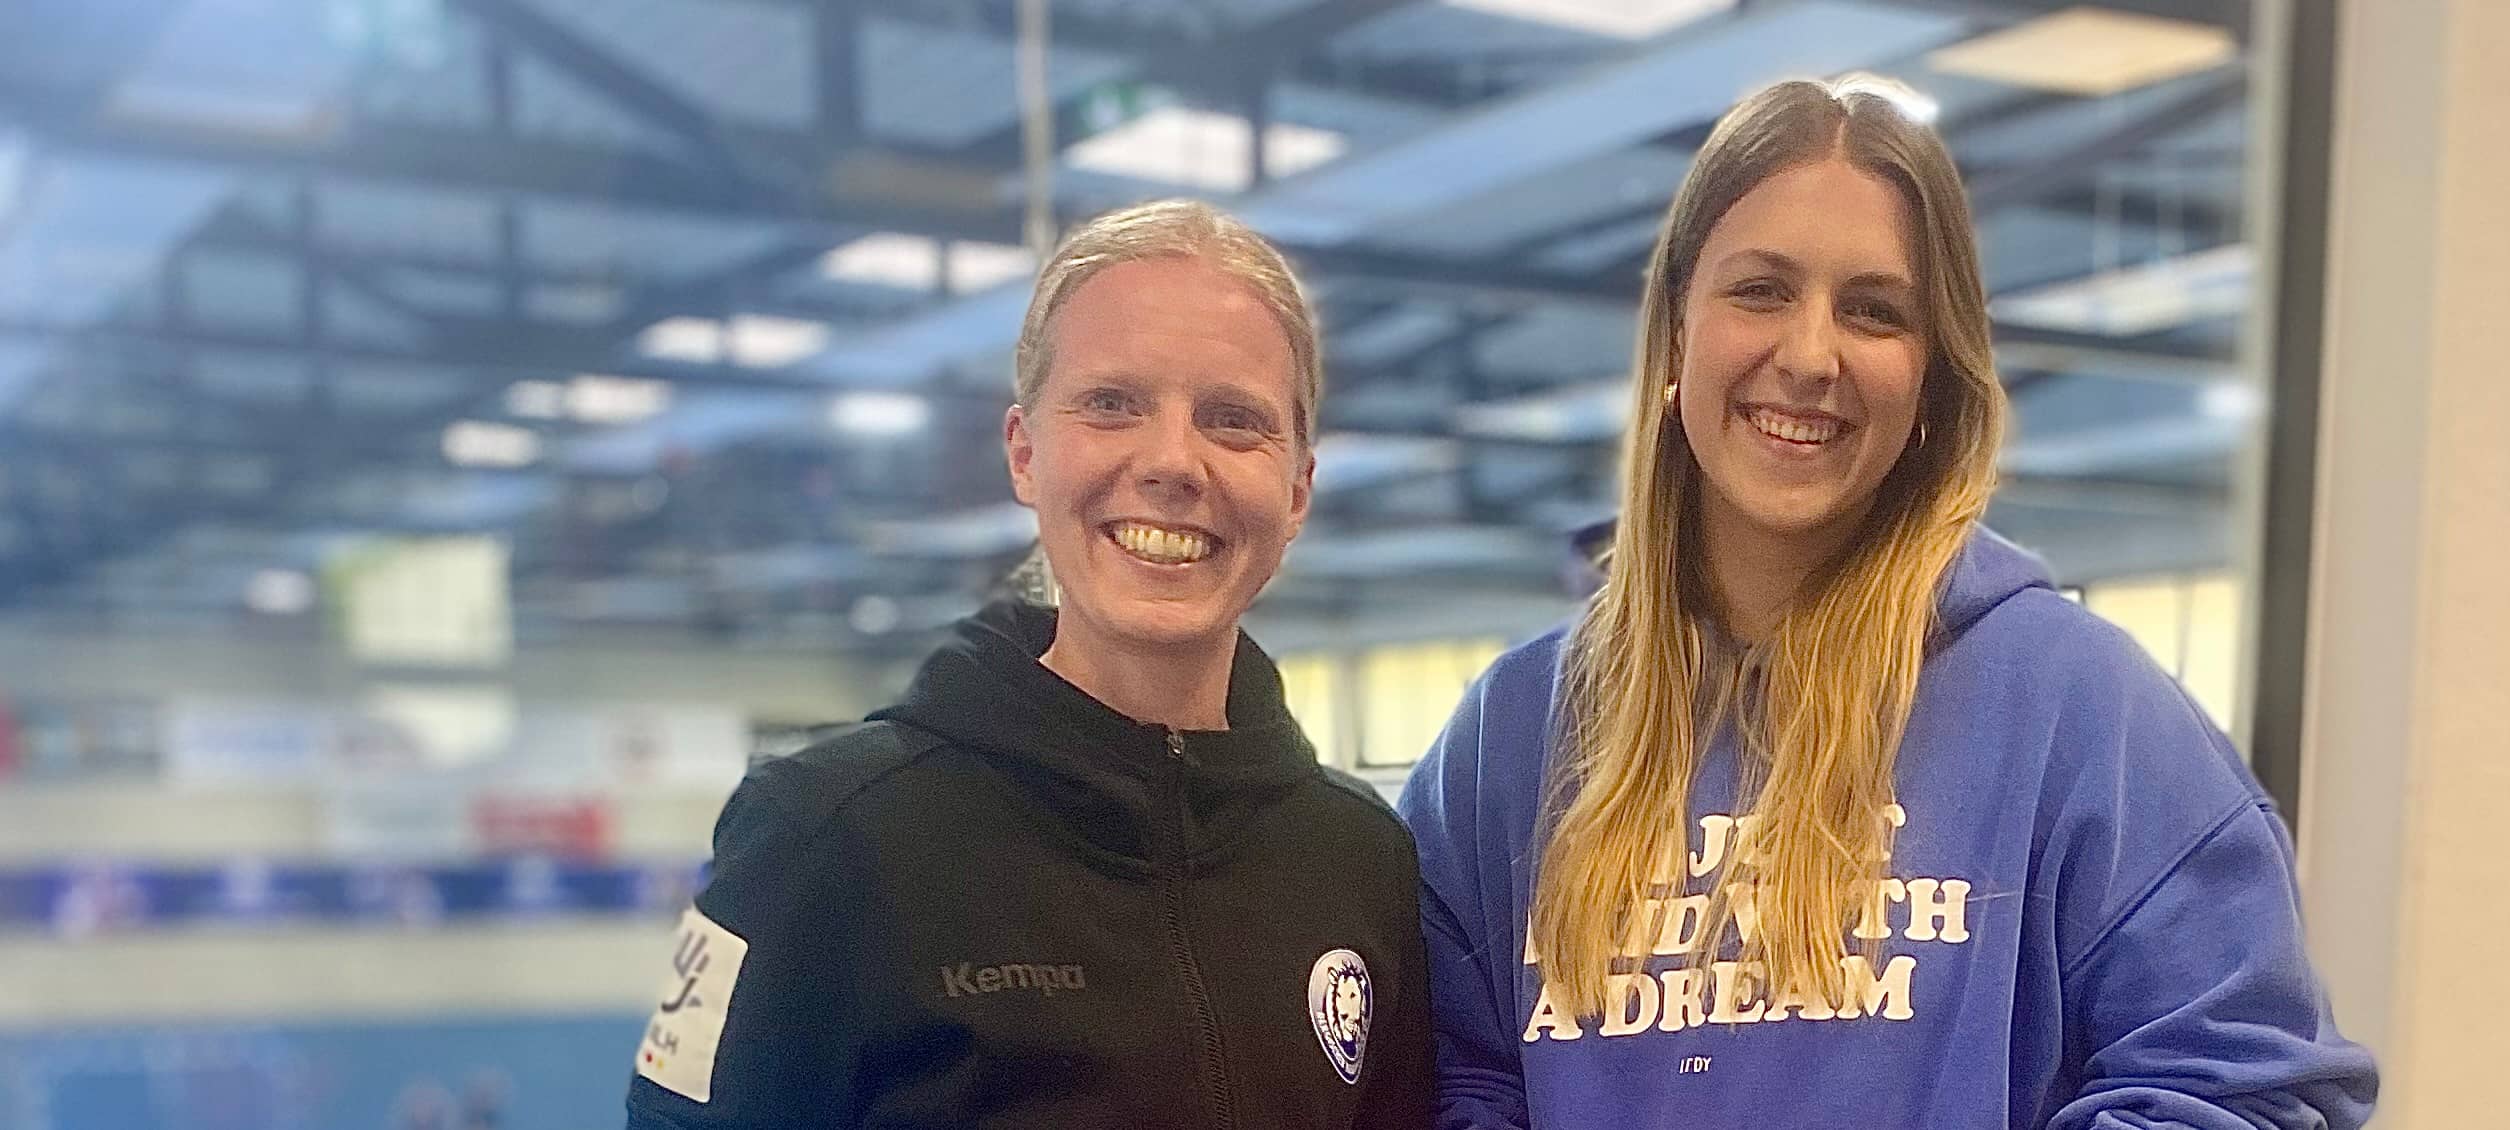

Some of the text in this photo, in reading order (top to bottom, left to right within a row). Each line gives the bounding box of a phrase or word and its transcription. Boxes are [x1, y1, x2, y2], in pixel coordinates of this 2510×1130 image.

[1726, 876, 1972, 944] WTH
[940, 961, 1086, 998] Kempa
[1523, 955, 1916, 1042] A DREAM
